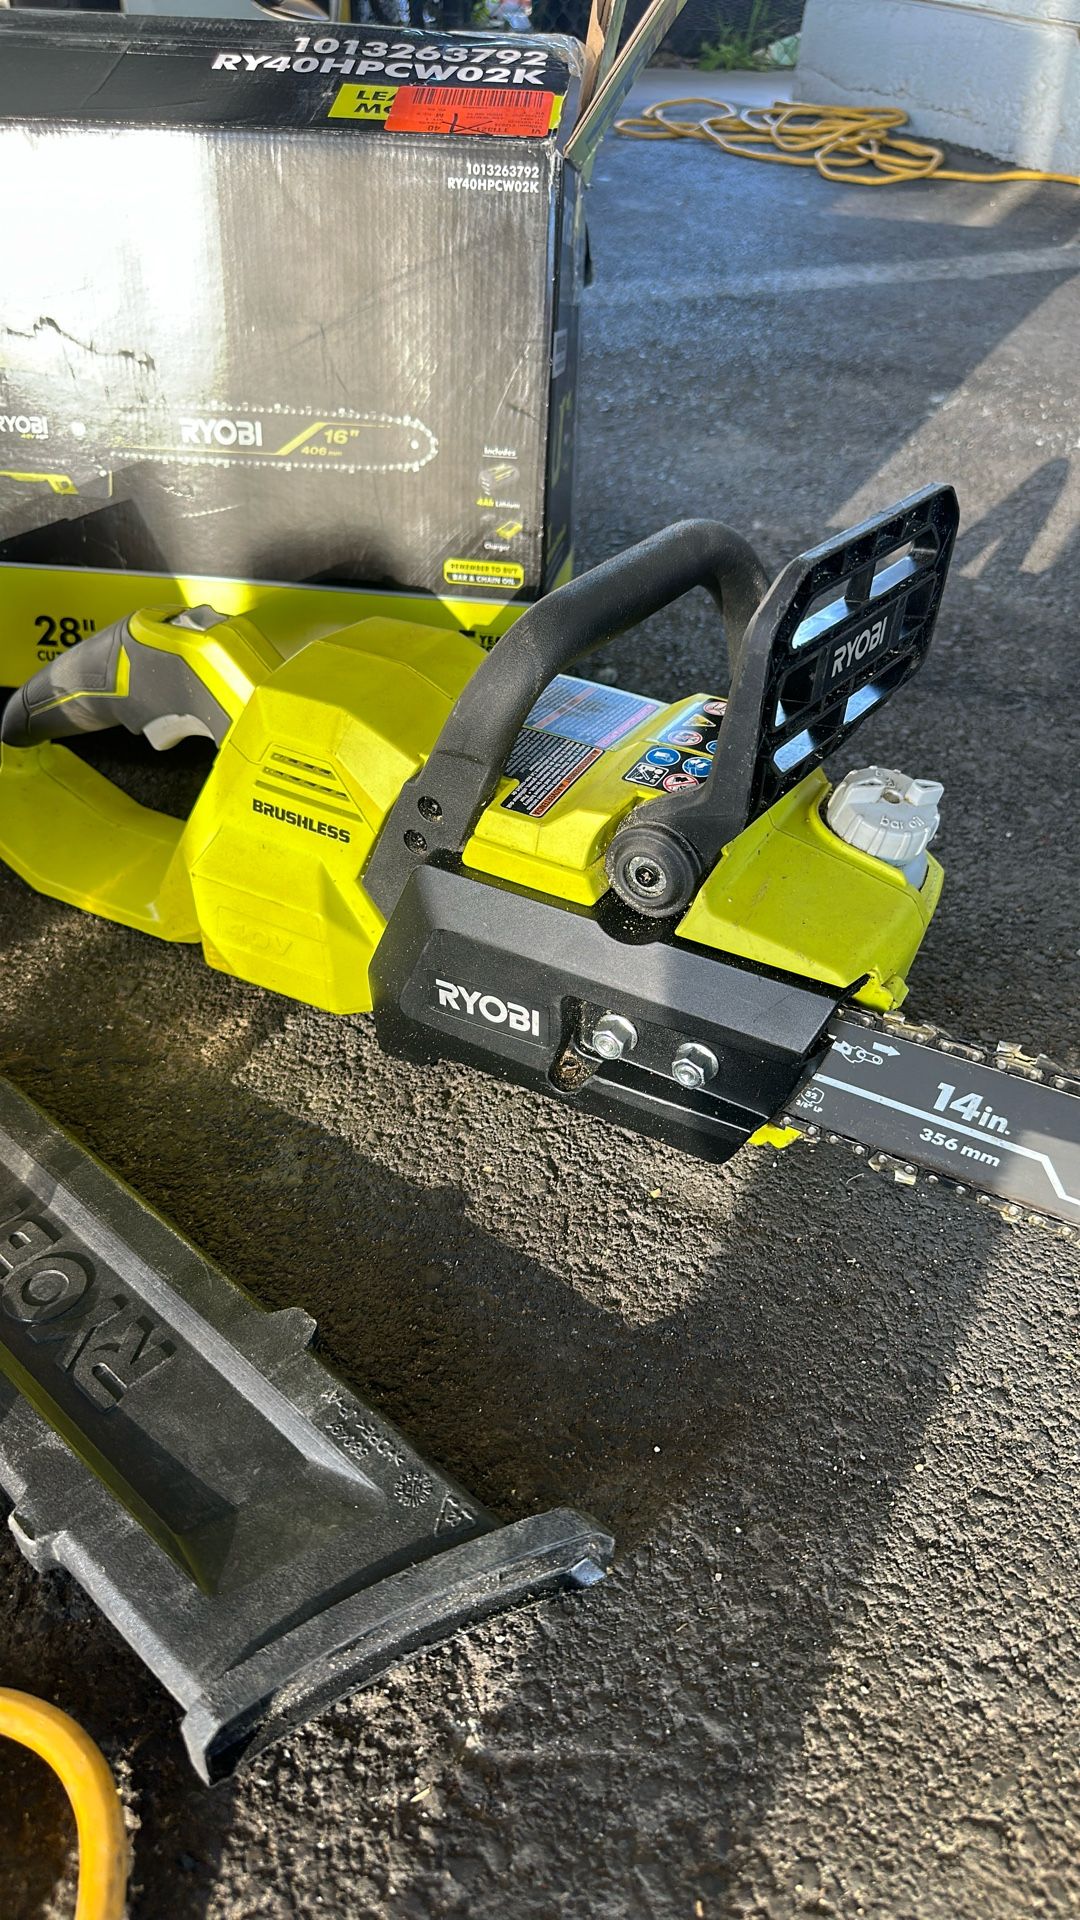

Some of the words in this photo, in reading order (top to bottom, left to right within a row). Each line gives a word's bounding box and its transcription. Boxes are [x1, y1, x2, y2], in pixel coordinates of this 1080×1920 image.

[293, 36, 548, 67] 1013263792
[211, 53, 547, 85] RY40HPCW02K
[356, 90, 397, 102] LE
[466, 162, 539, 178] 1013263792
[447, 177, 539, 193] RY40HPCW02K
[179, 417, 263, 447] RYOBI
[323, 429, 360, 444] 16"
[301, 447, 327, 457] 406
[484, 447, 517, 457] Includes
[451, 563, 490, 572] REMEMBER
[503, 567, 519, 575] BUY
[452, 573, 468, 581] BAR
[476, 575, 500, 584] CHAIN
[501, 577, 516, 585] OIL
[34, 615, 96, 648] 28"
[831, 616, 888, 679] RYOBI
[37, 650, 63, 662] CU
[252, 798, 351, 843] BRUSHLESS
[880, 815, 904, 830] bar
[908, 815, 925, 828] oil
[435, 979, 540, 1037] RYOBI
[919, 1127, 958, 1151] 356
[960, 1143, 1001, 1167] mm
